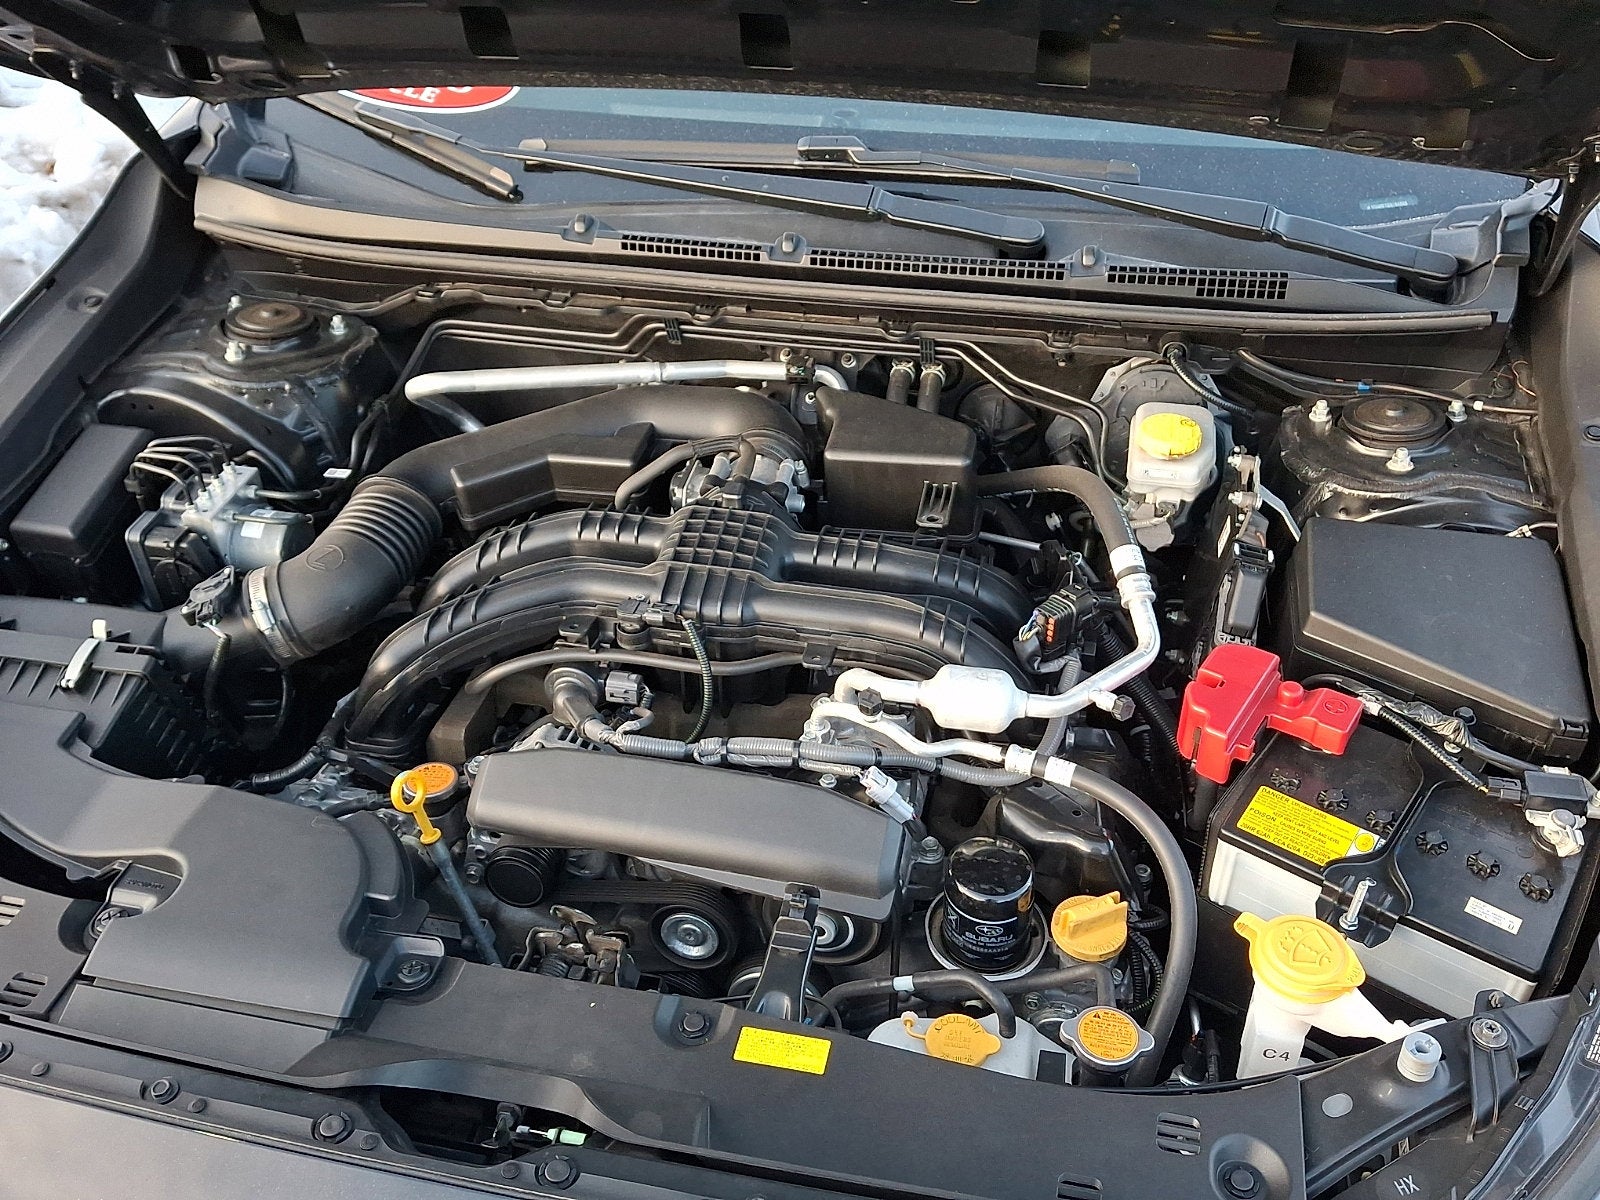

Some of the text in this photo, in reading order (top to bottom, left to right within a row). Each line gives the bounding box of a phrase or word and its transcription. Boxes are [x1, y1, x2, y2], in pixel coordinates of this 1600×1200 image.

[1261, 788, 1290, 803] DANGER
[1249, 807, 1277, 822] POISON
[965, 931, 1013, 942] SUBARU
[934, 1015, 983, 1034] COOLANT
[1262, 1048, 1290, 1061] C4
[1393, 1174, 1420, 1196] HX
